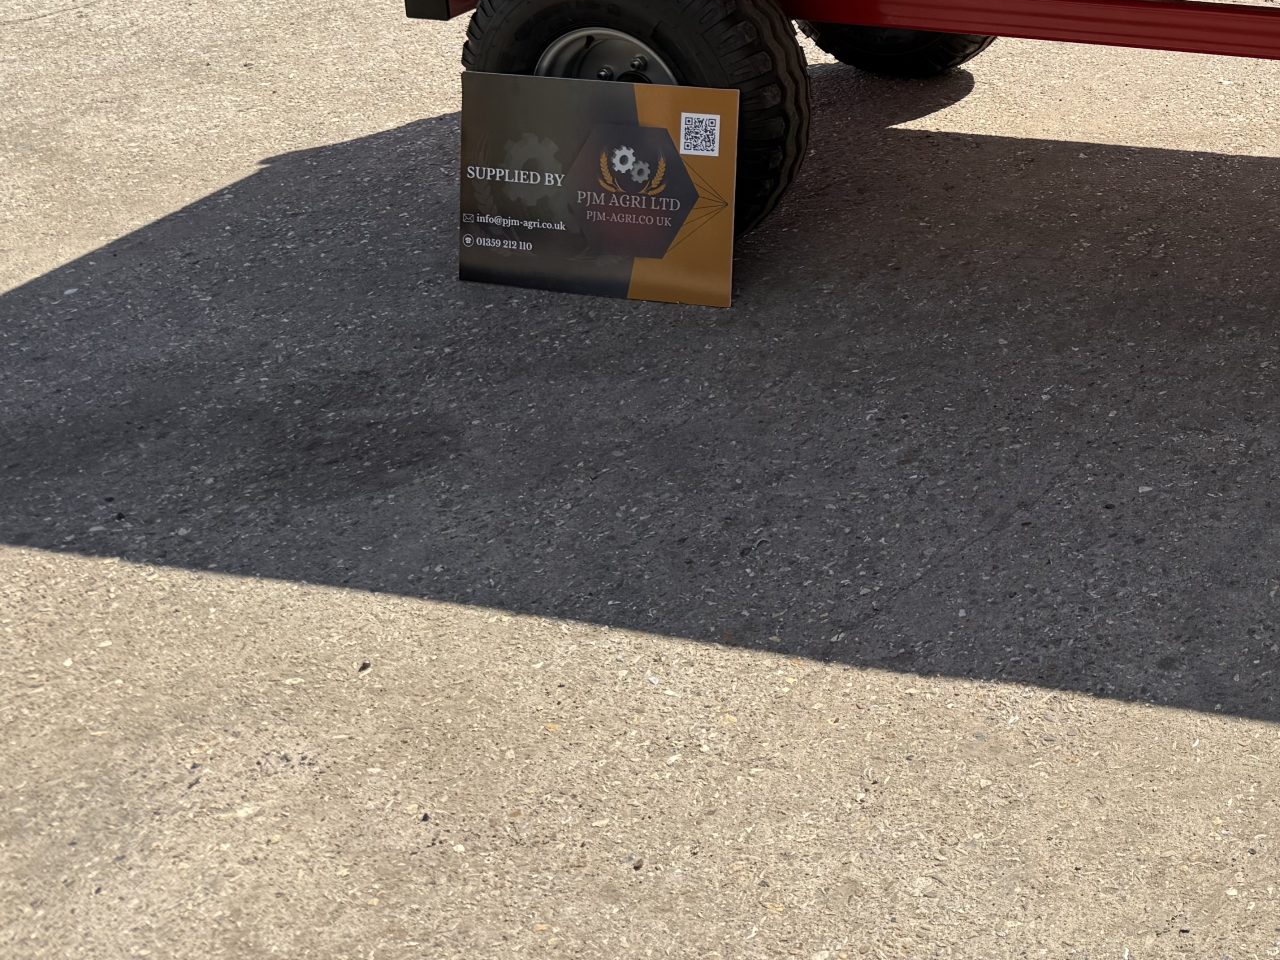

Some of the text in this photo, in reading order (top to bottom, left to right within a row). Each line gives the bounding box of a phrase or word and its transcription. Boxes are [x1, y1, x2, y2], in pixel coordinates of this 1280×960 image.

[466, 165, 565, 187] SUPPLIED BY
[577, 190, 680, 211] PJM AGRI LTD
[476, 213, 566, 231] info@pjm-agri.co.uk
[476, 237, 533, 251] 01359 212 110
